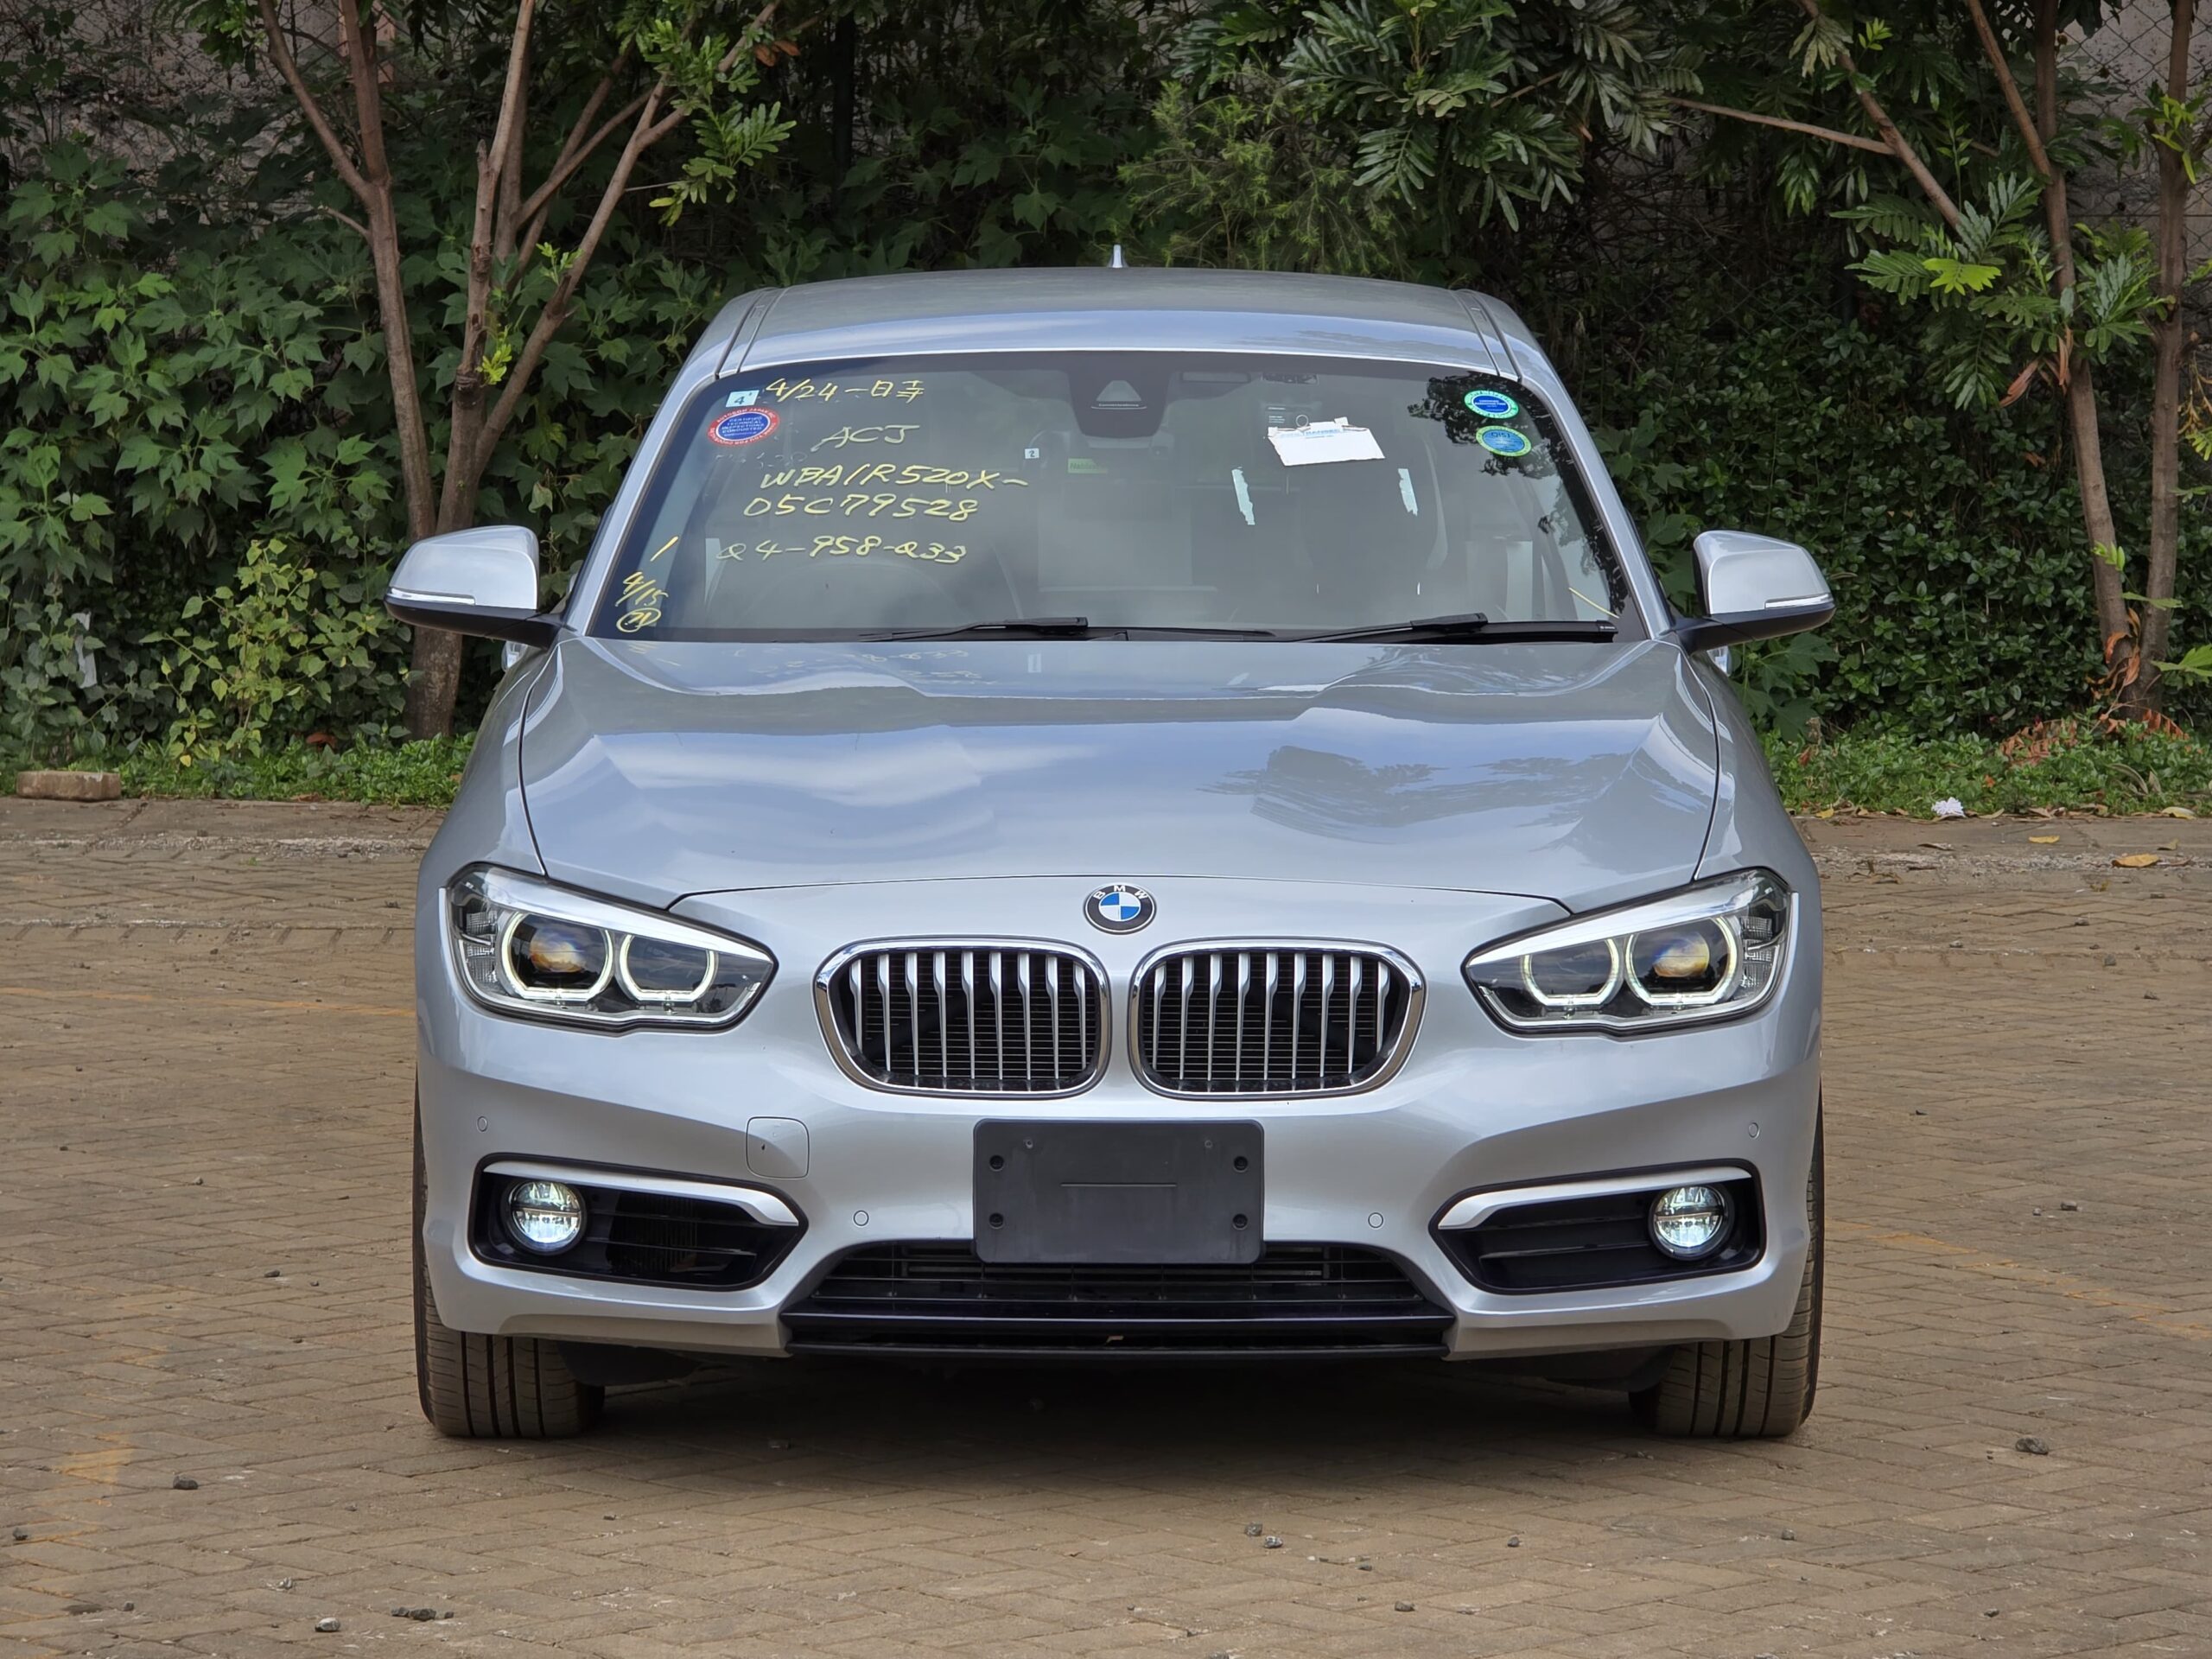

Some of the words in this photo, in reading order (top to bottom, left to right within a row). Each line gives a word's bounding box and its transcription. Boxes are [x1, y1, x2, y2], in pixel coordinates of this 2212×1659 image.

[810, 424, 921, 453] ACJ
[743, 493, 978, 522] 05C79528
[1093, 885, 1148, 899] BMW
